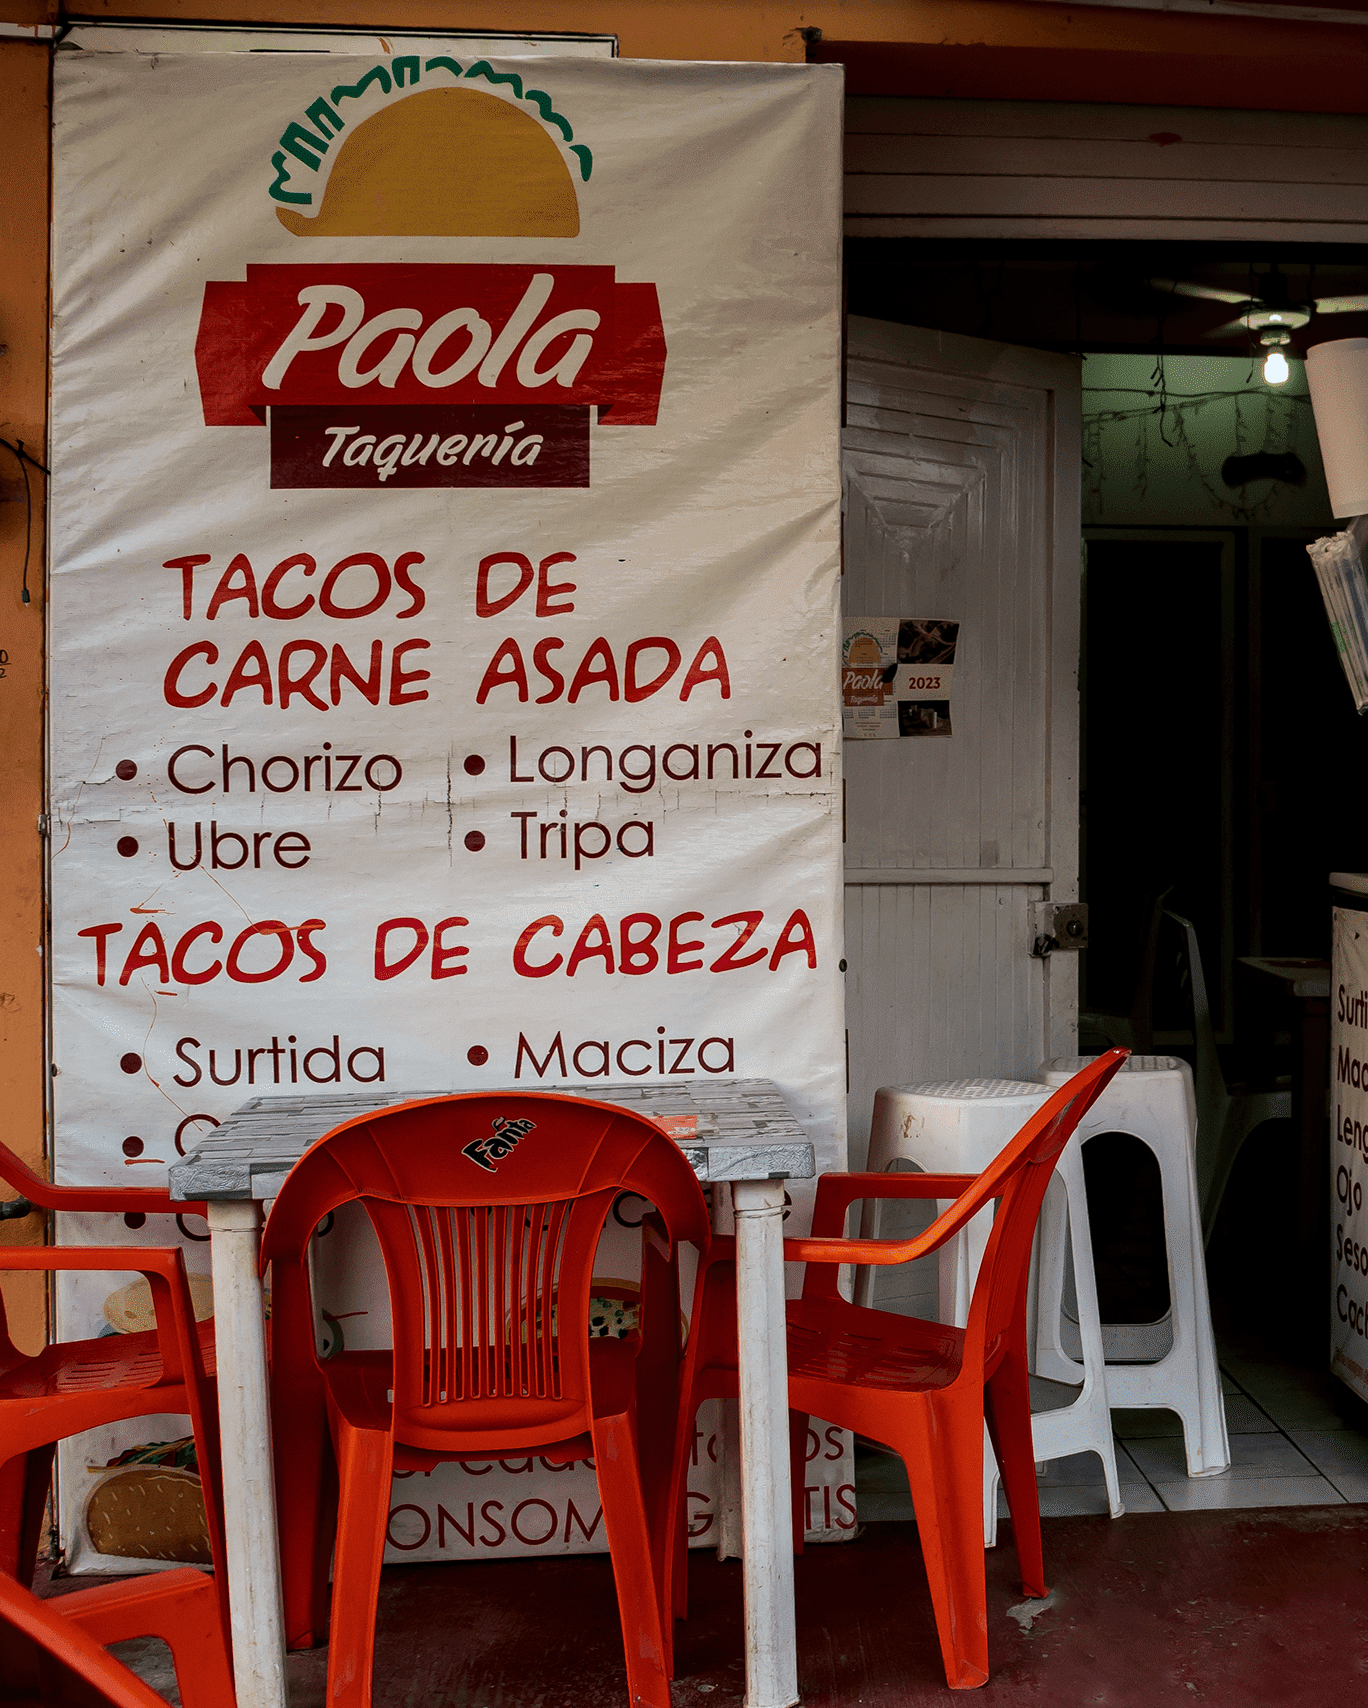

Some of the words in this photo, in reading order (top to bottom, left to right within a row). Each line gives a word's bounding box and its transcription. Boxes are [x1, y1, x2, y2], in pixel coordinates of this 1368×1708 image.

[262, 272, 601, 389] Paola
[322, 421, 544, 482] Taquería
[162, 550, 428, 621] TACOS
[475, 550, 579, 618] DE
[162, 636, 432, 711] CARNE
[475, 635, 733, 706] ASADA
[842, 669, 887, 690] Paola
[908, 676, 942, 690] 2023
[166, 742, 404, 796] Chorizo
[508, 729, 824, 794] Longaniza
[166, 820, 313, 872] Ubre
[510, 810, 656, 871] Tripa
[77, 918, 329, 988] TACOS
[373, 915, 470, 981] DE
[513, 908, 818, 978] CABEZA
[173, 1033, 387, 1088] Surtida
[514, 1024, 737, 1080] Maciza
[461, 1116, 538, 1174] Fanta
[1336, 1164, 1363, 1218] Ojo
[384, 1497, 611, 1553] ONSOM
[686, 1483, 858, 1538] GTIS
